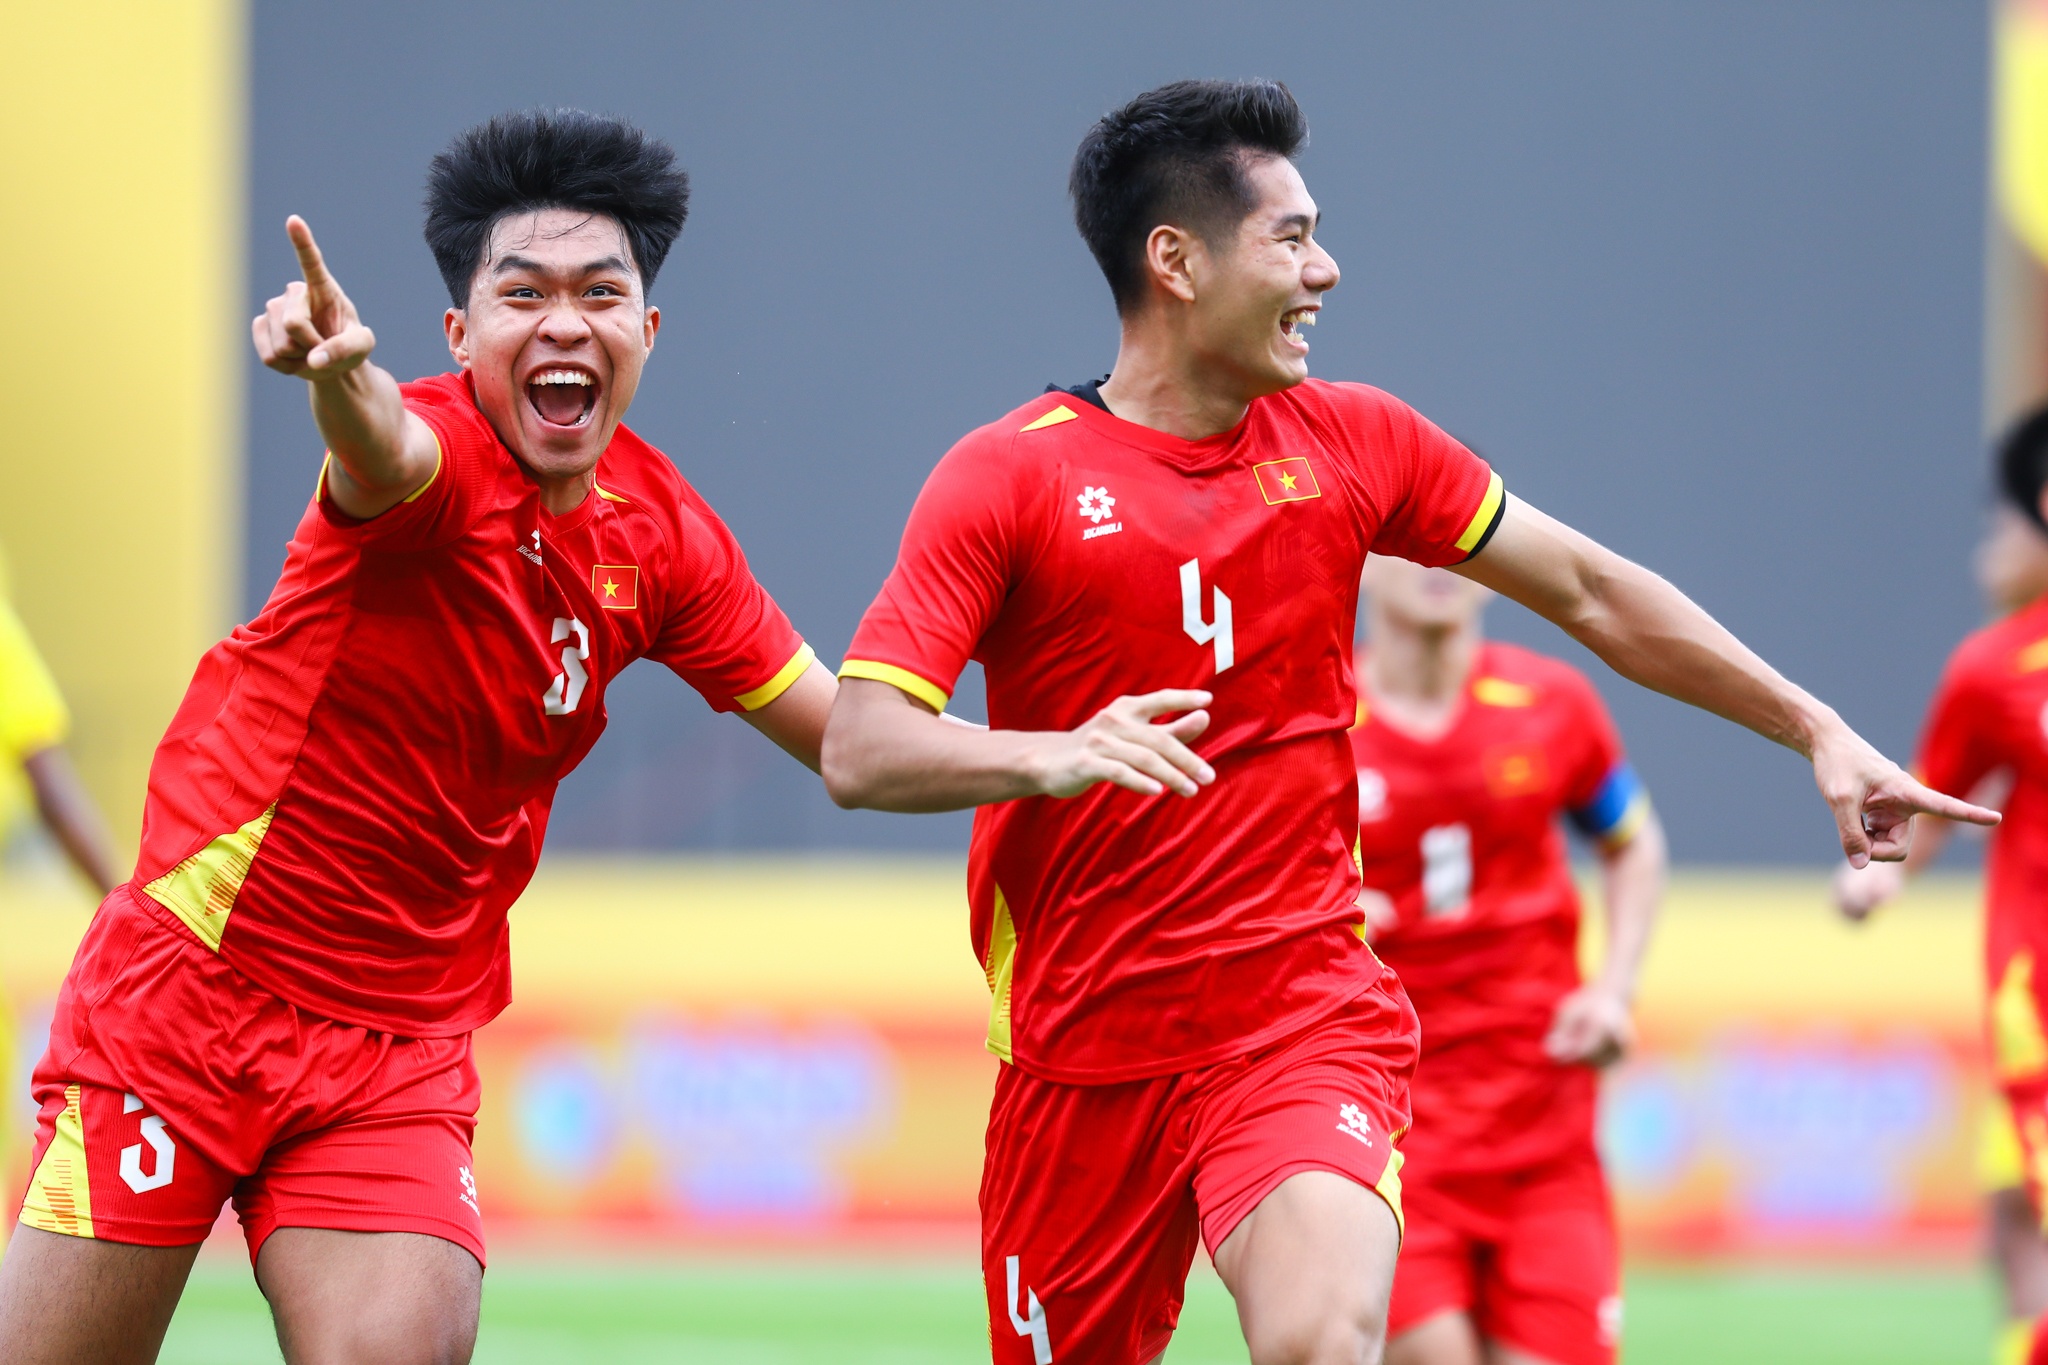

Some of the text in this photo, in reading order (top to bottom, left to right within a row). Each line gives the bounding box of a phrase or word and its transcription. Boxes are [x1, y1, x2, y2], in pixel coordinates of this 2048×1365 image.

[542, 613, 589, 715] 3
[1179, 557, 1234, 675] 4
[119, 1093, 176, 1195] 3
[1006, 1255, 1053, 1365] 4
